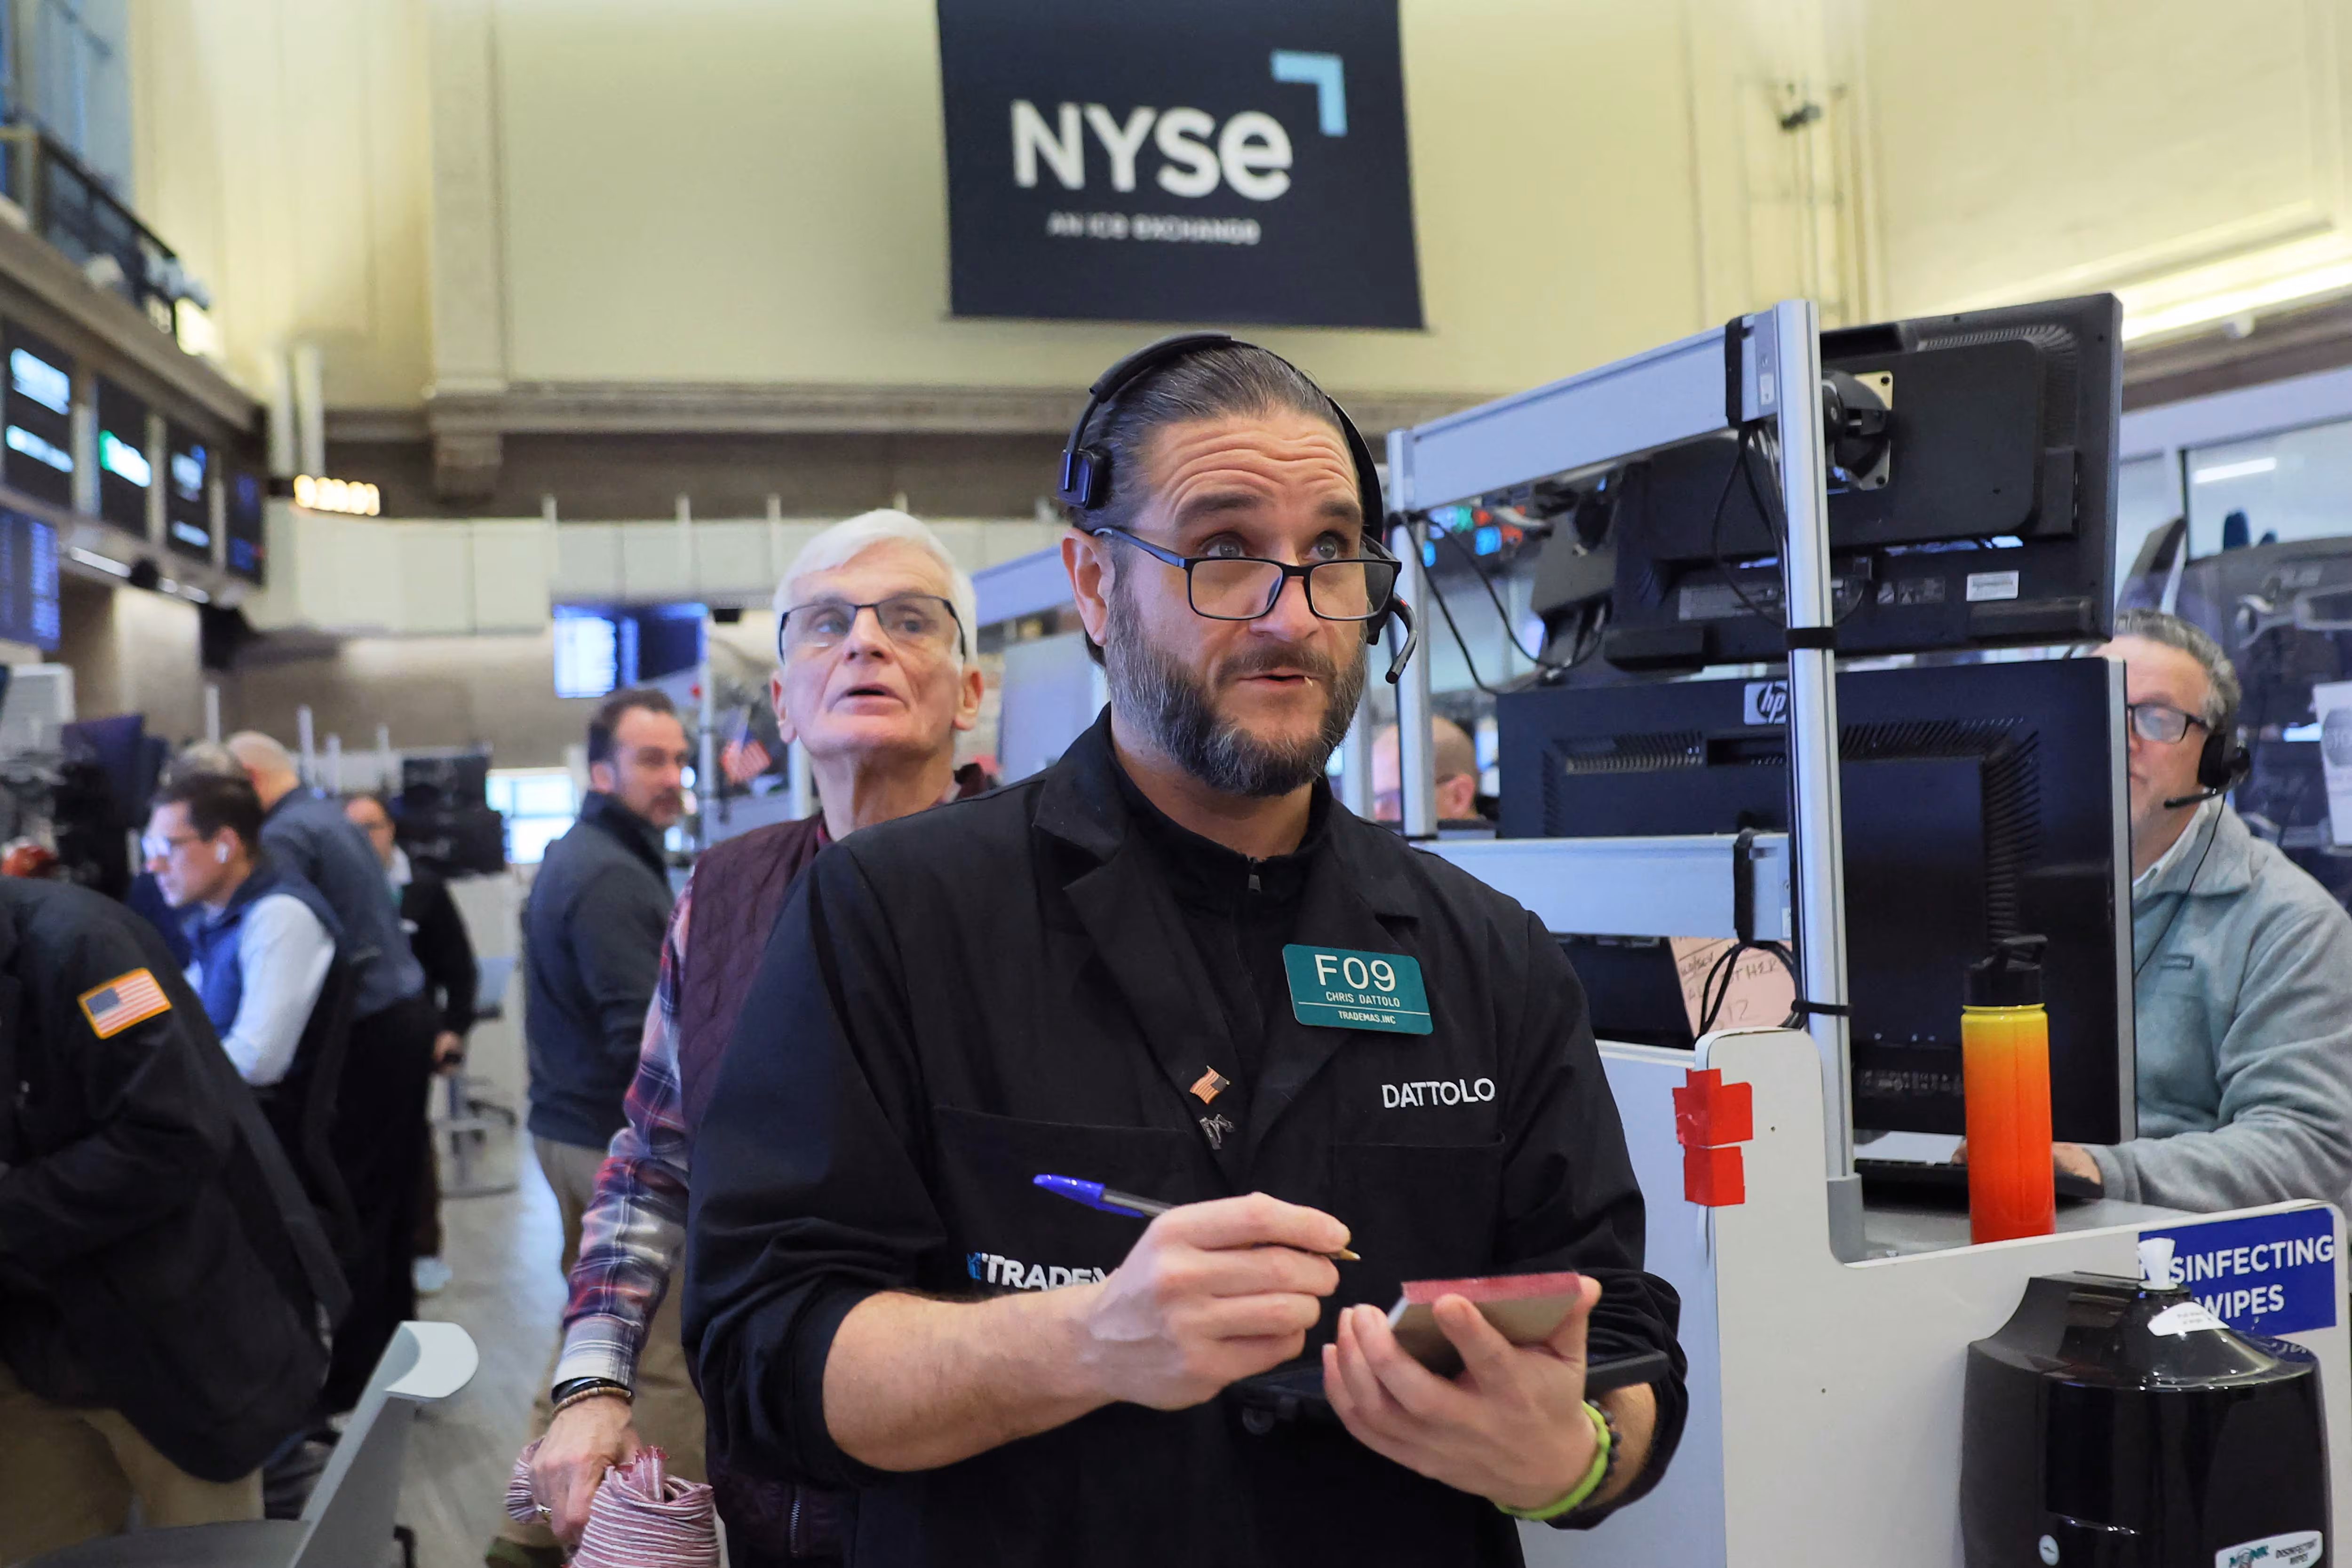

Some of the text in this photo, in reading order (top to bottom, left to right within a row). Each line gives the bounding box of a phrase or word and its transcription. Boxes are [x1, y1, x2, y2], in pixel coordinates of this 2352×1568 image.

[1761, 682, 1787, 723] hp
[1315, 954, 1396, 992] F09
[1326, 991, 1400, 1007] CHRIS DATTOLO
[1382, 1078, 1495, 1109] DATTOLO
[2140, 1235, 2334, 1284] SINFECTING
